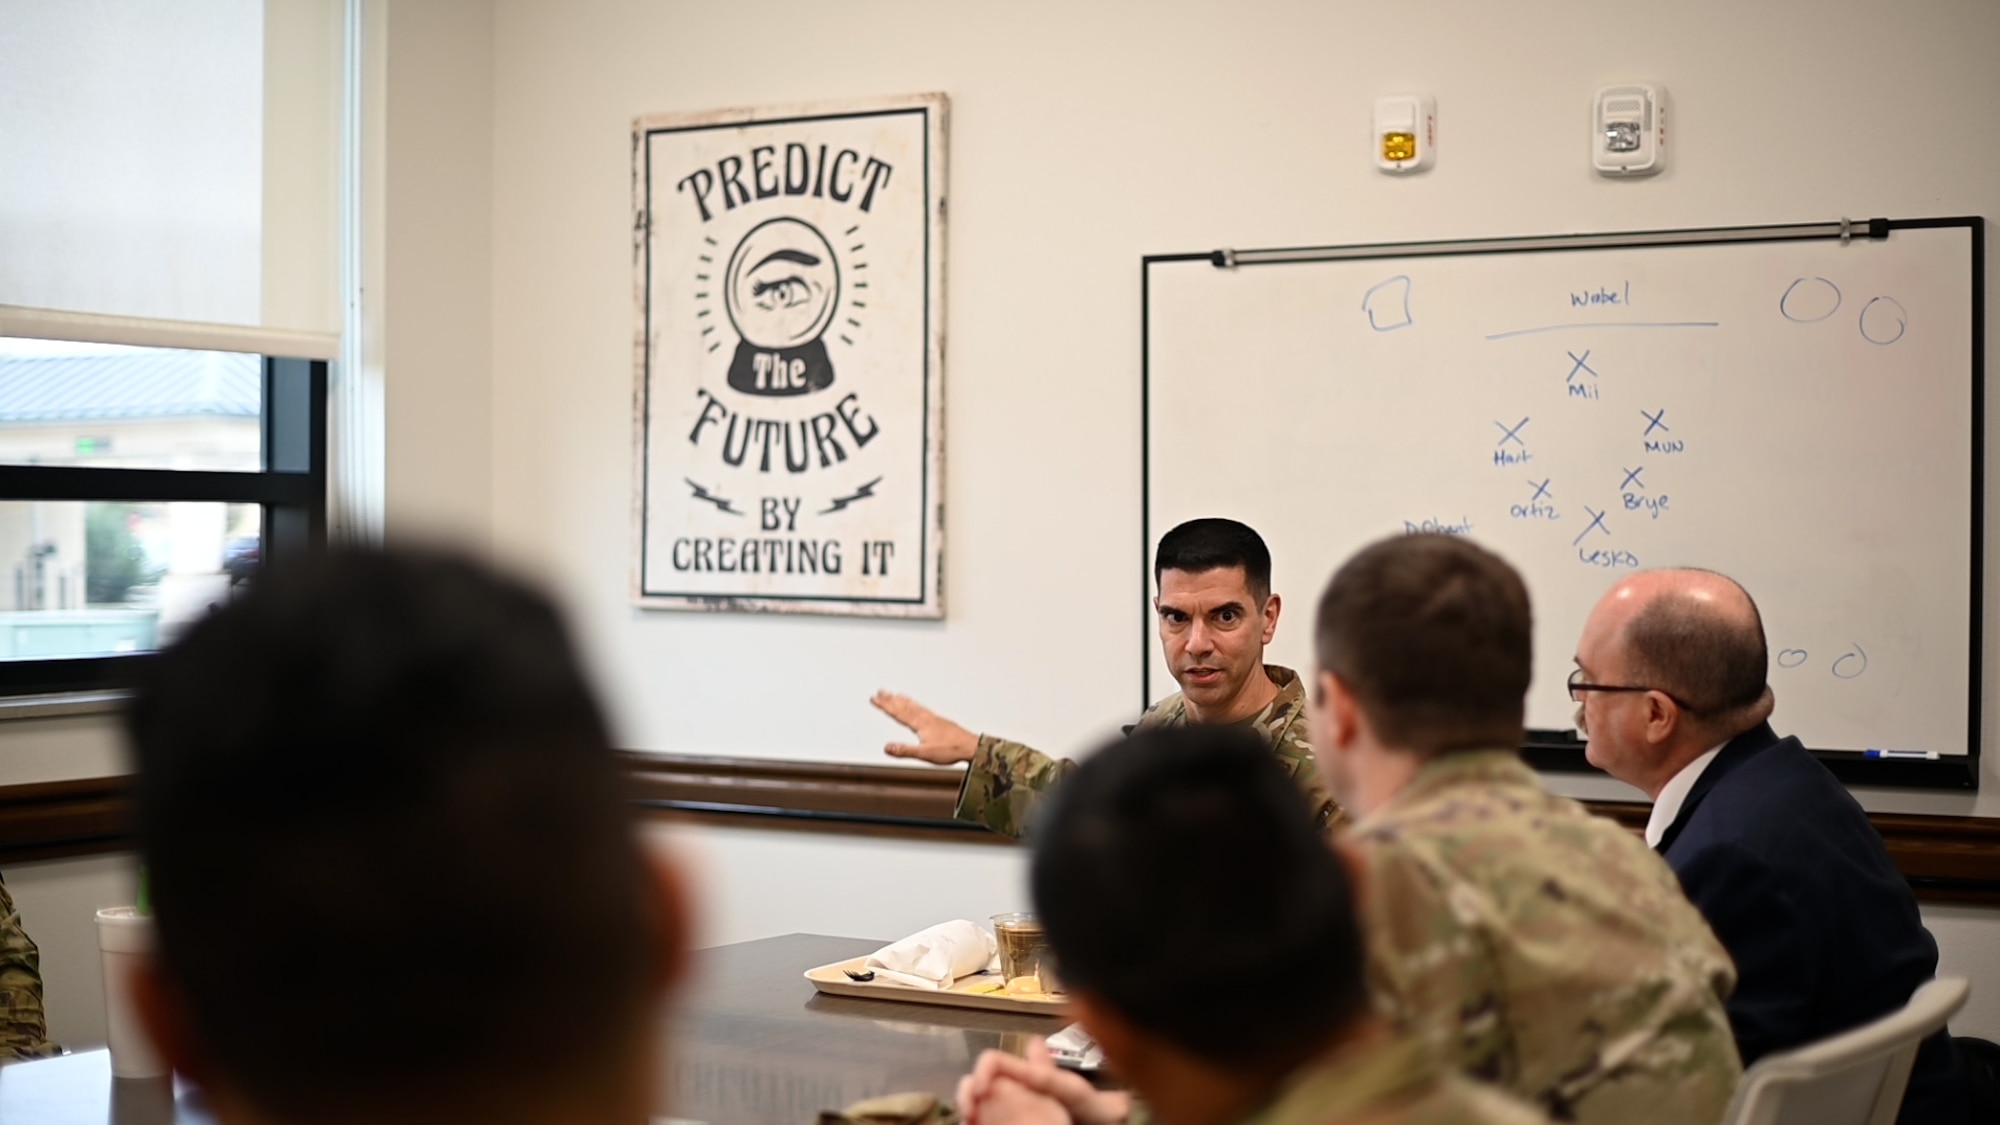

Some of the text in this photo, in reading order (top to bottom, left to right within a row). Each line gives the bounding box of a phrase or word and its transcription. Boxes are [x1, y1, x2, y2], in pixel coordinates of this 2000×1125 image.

[677, 142, 893, 222] PREDICT
[753, 353, 807, 390] The
[688, 389, 880, 474] FUTURE
[761, 497, 801, 531] BY
[672, 538, 895, 575] CREATING IT
